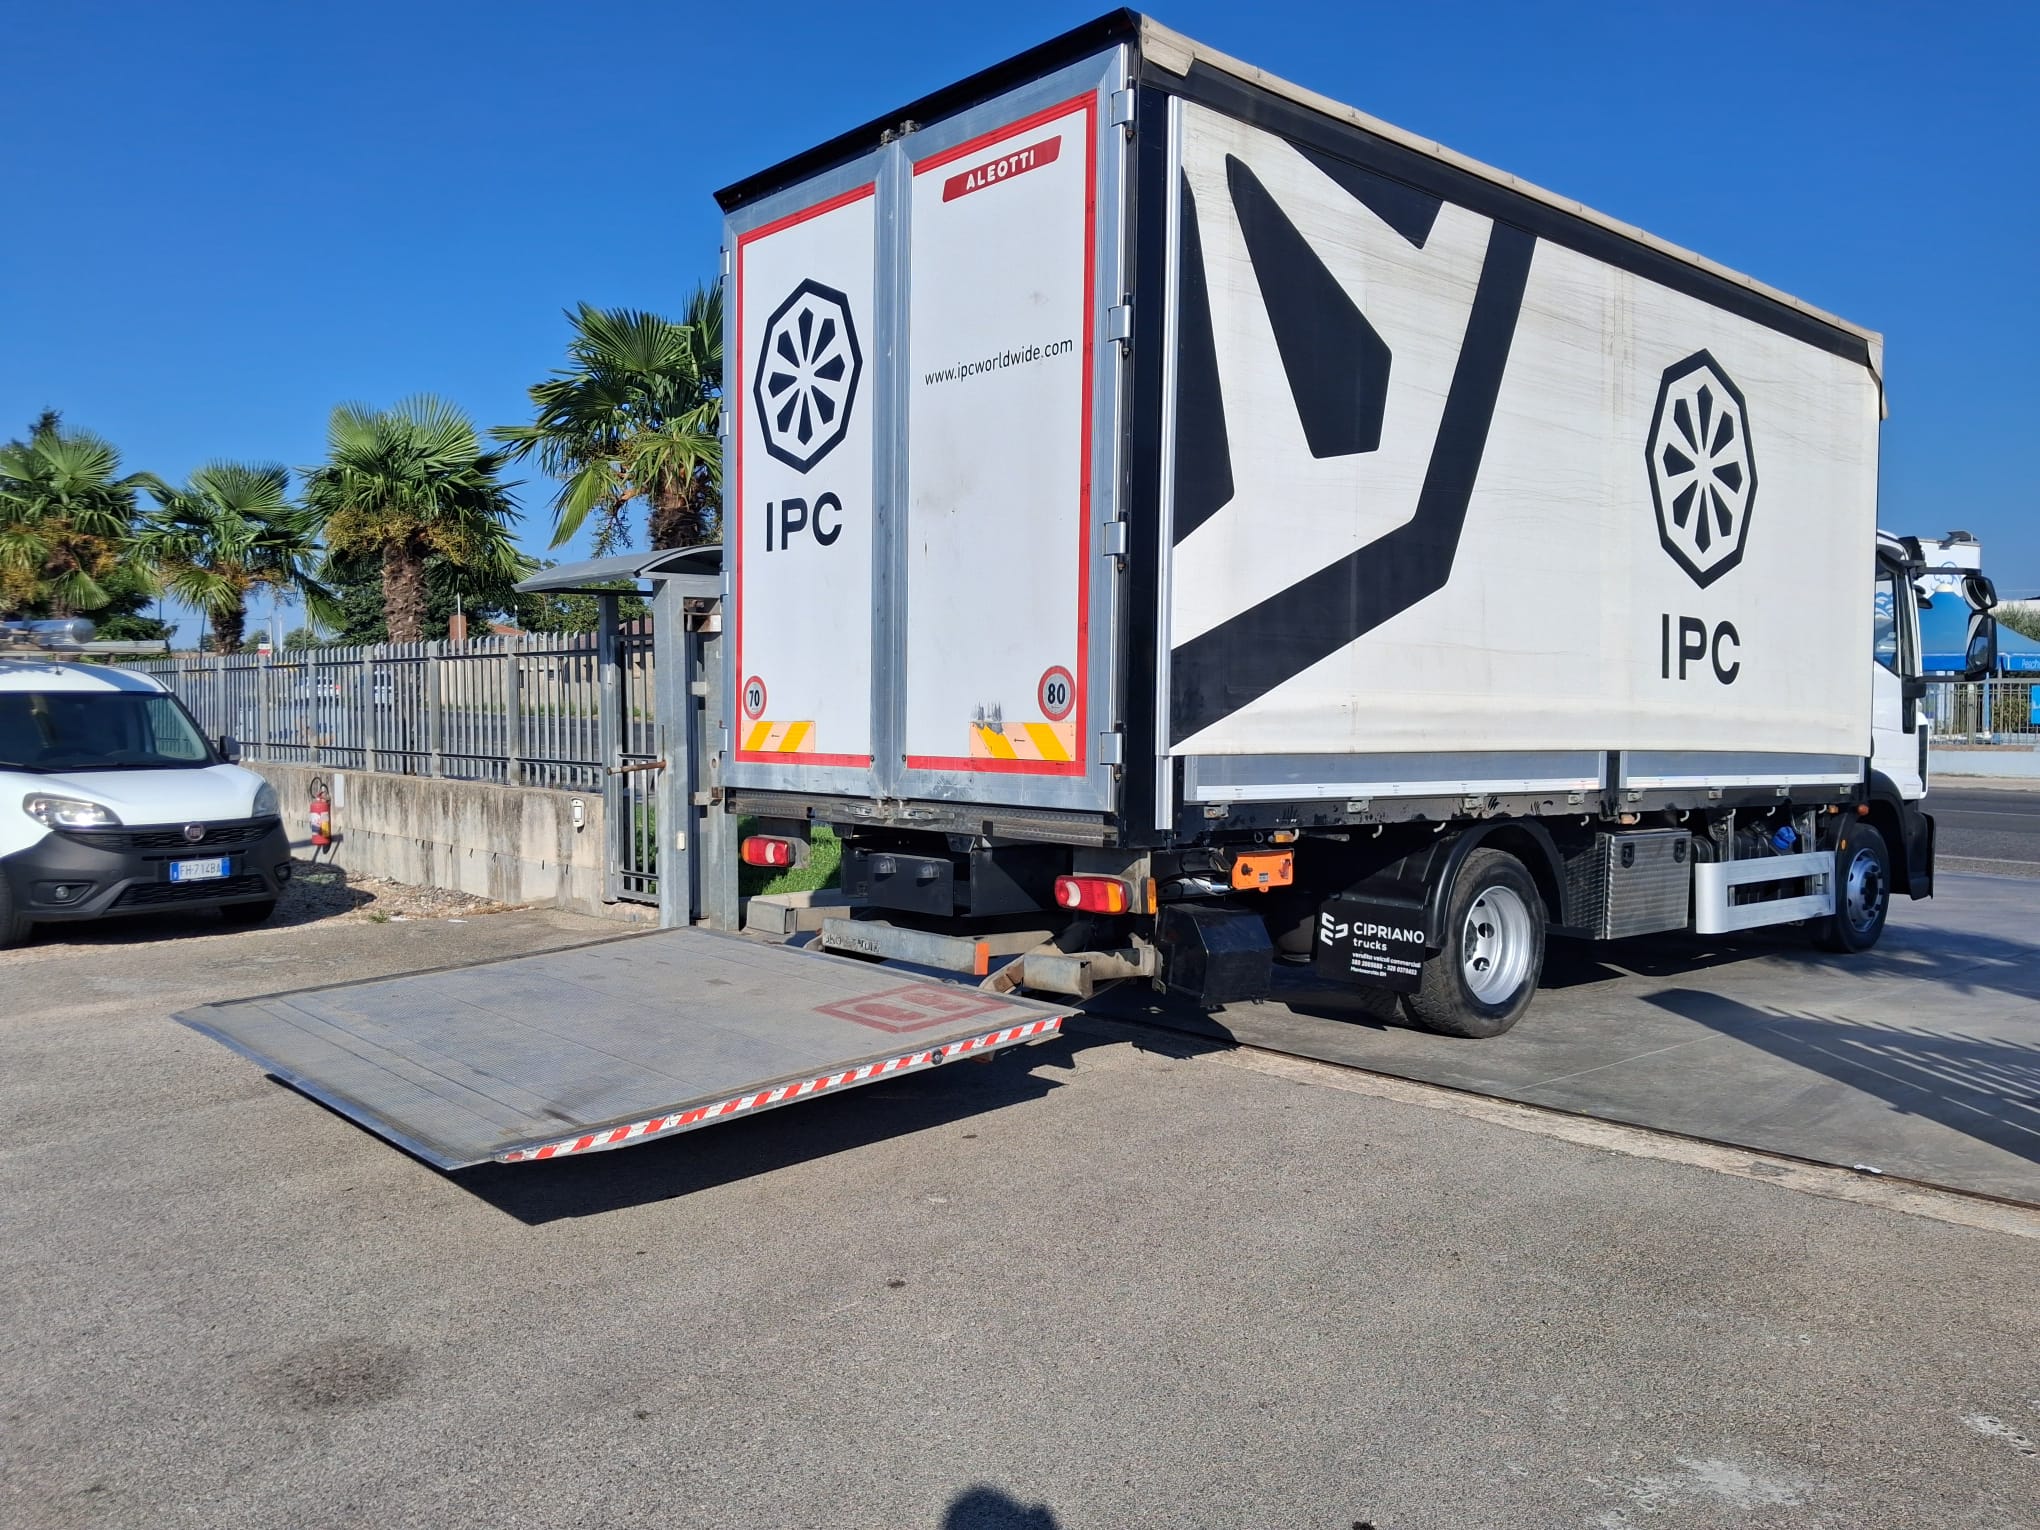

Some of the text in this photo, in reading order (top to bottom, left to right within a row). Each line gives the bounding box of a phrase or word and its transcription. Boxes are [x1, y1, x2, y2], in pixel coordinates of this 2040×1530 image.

[966, 149, 1035, 191] ALEOTTI
[924, 339, 1073, 386] www.ipcworldwide.com
[766, 491, 843, 552] IPC
[1661, 613, 1741, 685] IPC
[749, 689, 760, 707] 70
[1047, 682, 1066, 705] 80
[1353, 922, 1425, 944] CIPRIANO
[1353, 938, 1388, 951] trucks
